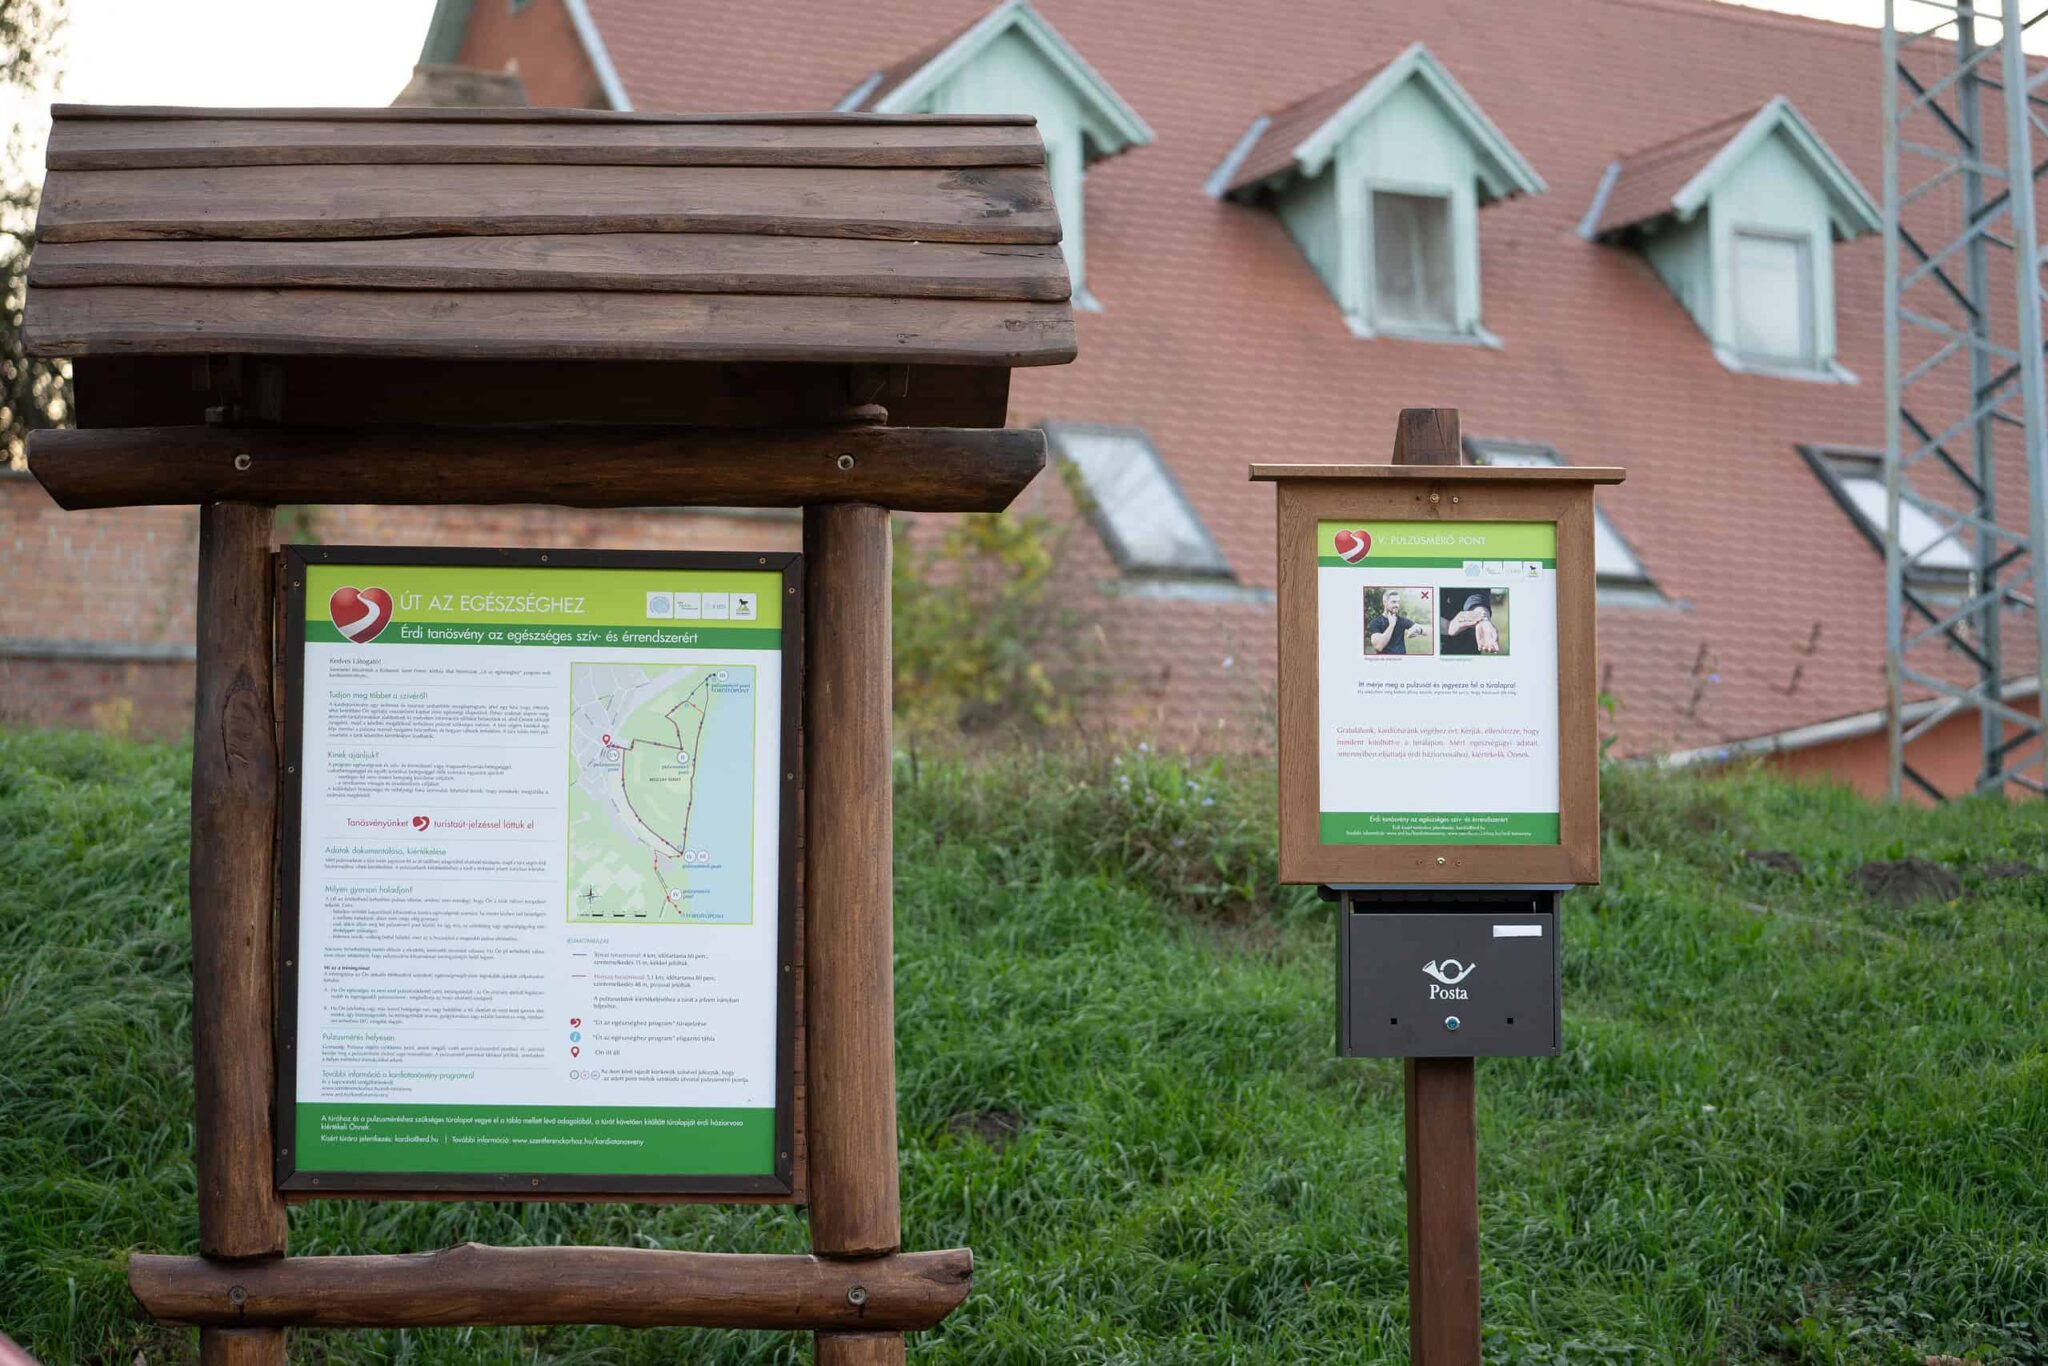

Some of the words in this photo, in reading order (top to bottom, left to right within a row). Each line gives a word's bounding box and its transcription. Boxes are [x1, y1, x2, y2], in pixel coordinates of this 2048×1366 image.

[400, 590, 422, 610] ÚT
[429, 595, 453, 611] AZ
[461, 591, 584, 613] EGÉSZSÉGHEZ
[401, 624, 423, 638] Érdi
[428, 626, 484, 643] tanösvény
[489, 631, 503, 640] az
[508, 626, 572, 643] egészséges
[577, 628, 601, 641] szív-
[606, 629, 618, 642] és
[622, 628, 698, 643] érrendszerért
[347, 818, 408, 828] Tanösvényünket
[434, 820, 501, 831] turistaút-jelzéssel
[503, 820, 524, 829] láttuk
[527, 821, 534, 829] el
[325, 885, 348, 894] Milyen
[1430, 984, 1468, 999] Posta
